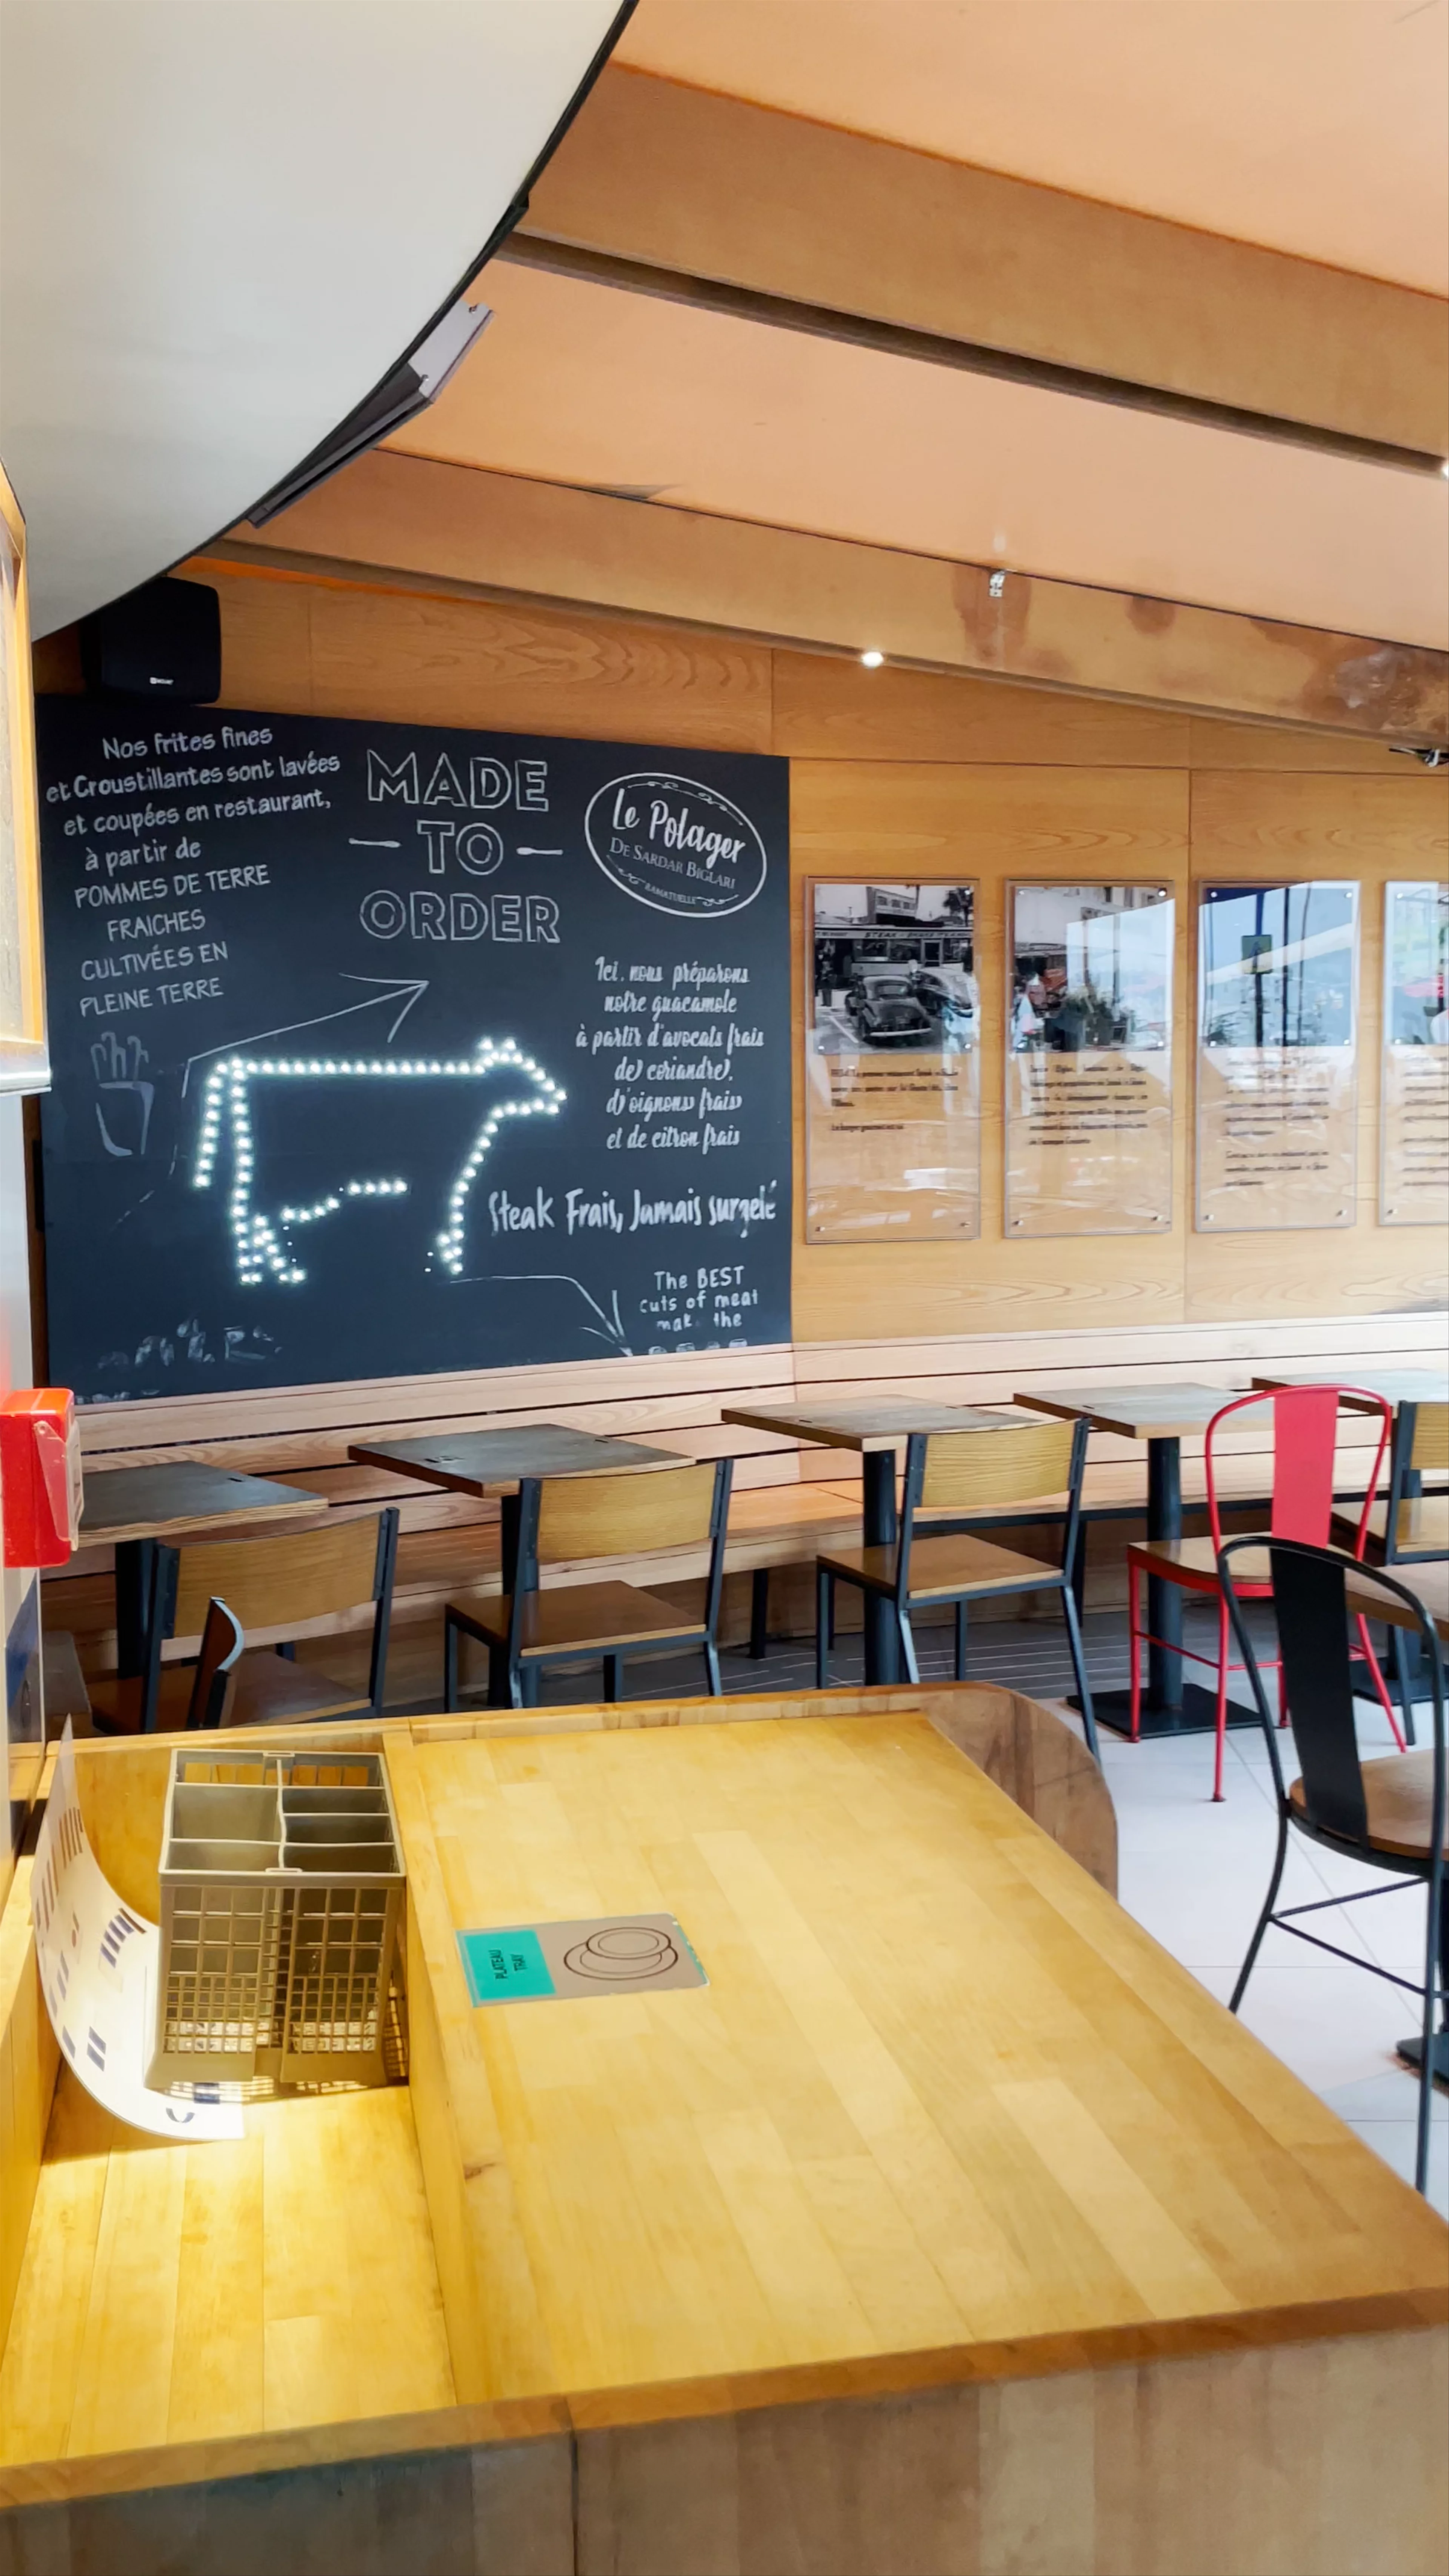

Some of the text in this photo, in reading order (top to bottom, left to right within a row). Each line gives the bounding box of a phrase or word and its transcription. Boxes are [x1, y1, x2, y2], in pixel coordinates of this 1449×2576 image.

[102, 726, 273, 759] Nos frites fines
[46, 751, 340, 803] et Croustillantes sont lavées
[368, 750, 549, 812] MADE
[64, 789, 331, 837] et coupées en restaurant,
[613, 788, 640, 830] Le
[85, 837, 201, 877] à partir de
[417, 820, 504, 876] TO
[74, 864, 271, 909] POMMES DE TERRE
[107, 909, 206, 941] FRAICHES
[360, 890, 560, 943] ORDER
[82, 941, 228, 980] CULTIVÉES EN
[629, 966, 663, 982] nous
[672, 961, 750, 991] préparons
[80, 977, 224, 1017] PLEINE TERRE
[652, 988, 737, 1021] guacamole
[576, 1023, 589, 1047] à
[592, 1025, 642, 1055] partir
[727, 1023, 764, 1055] frais
[614, 1056, 643, 1081] de
[699, 1087, 742, 1119] frais
[606, 1123, 740, 1155] et de citron frais
[489, 1186, 555, 1235] Steak
[565, 1188, 623, 1235] Frais,
[629, 1188, 701, 1231] Jamais
[654, 1265, 744, 1290] The BEST
[640, 1289, 758, 1313] cuts of meat
[713, 1311, 742, 1327] the
[488, 1949, 508, 1979] PLATEAU
[510, 1953, 529, 1972] TRAY
